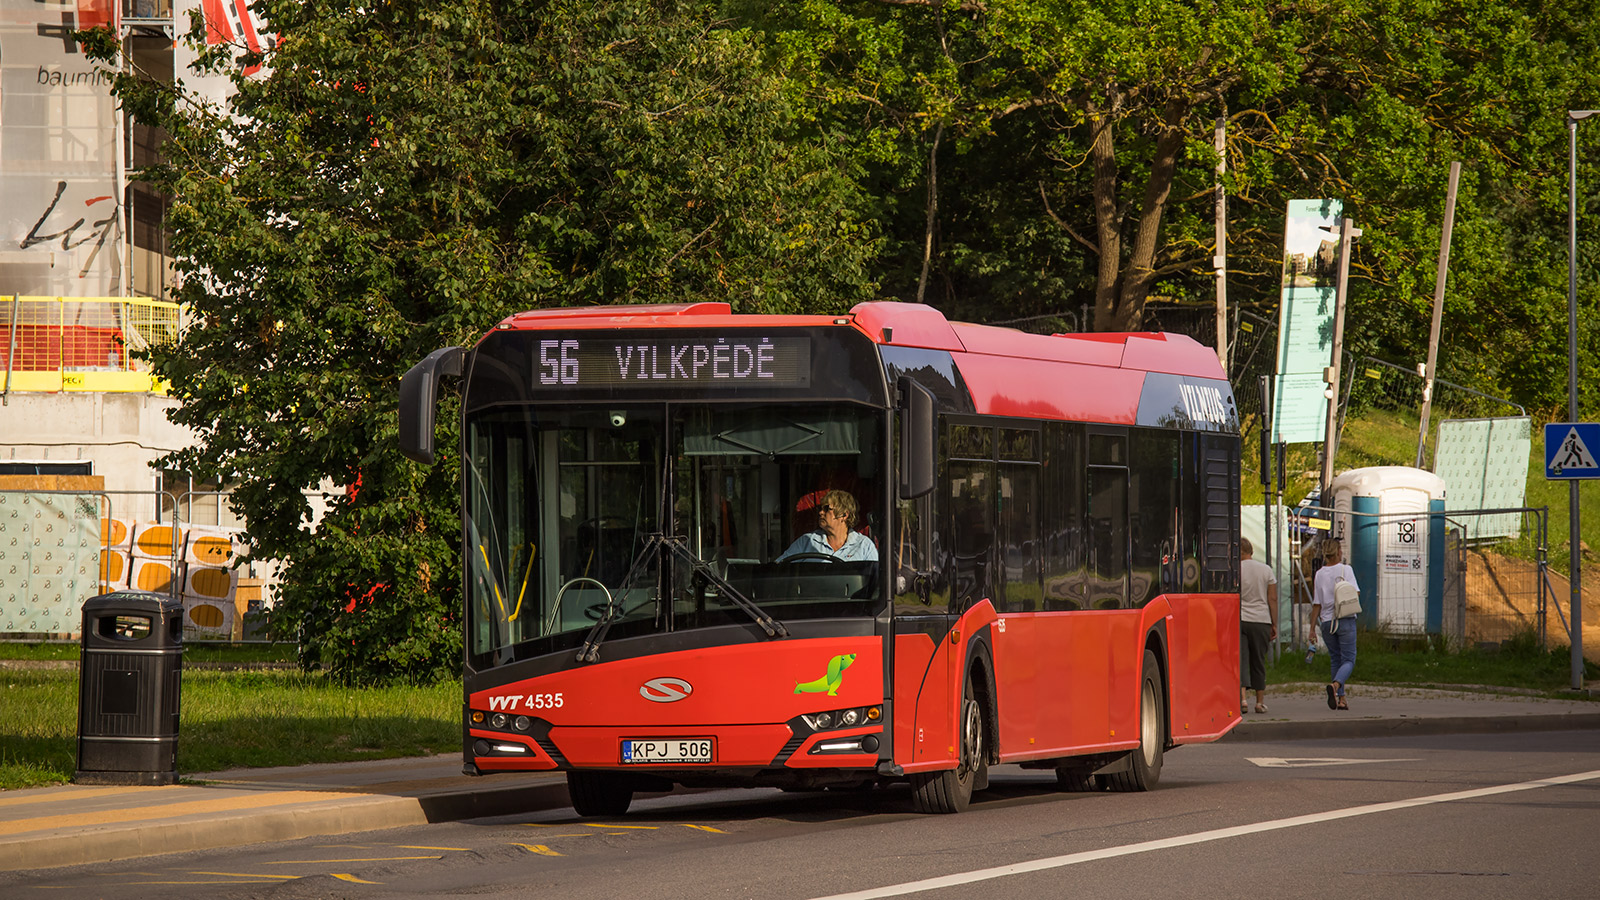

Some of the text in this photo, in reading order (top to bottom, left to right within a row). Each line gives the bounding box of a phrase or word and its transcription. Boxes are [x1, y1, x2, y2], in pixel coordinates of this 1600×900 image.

[540, 338, 774, 384] 56 VILKPĖDĖ
[1179, 384, 1226, 424] VILNIUS
[1397, 533, 1415, 543] TOI
[525, 693, 564, 709] 4535
[633, 743, 709, 757] KPJ 506
